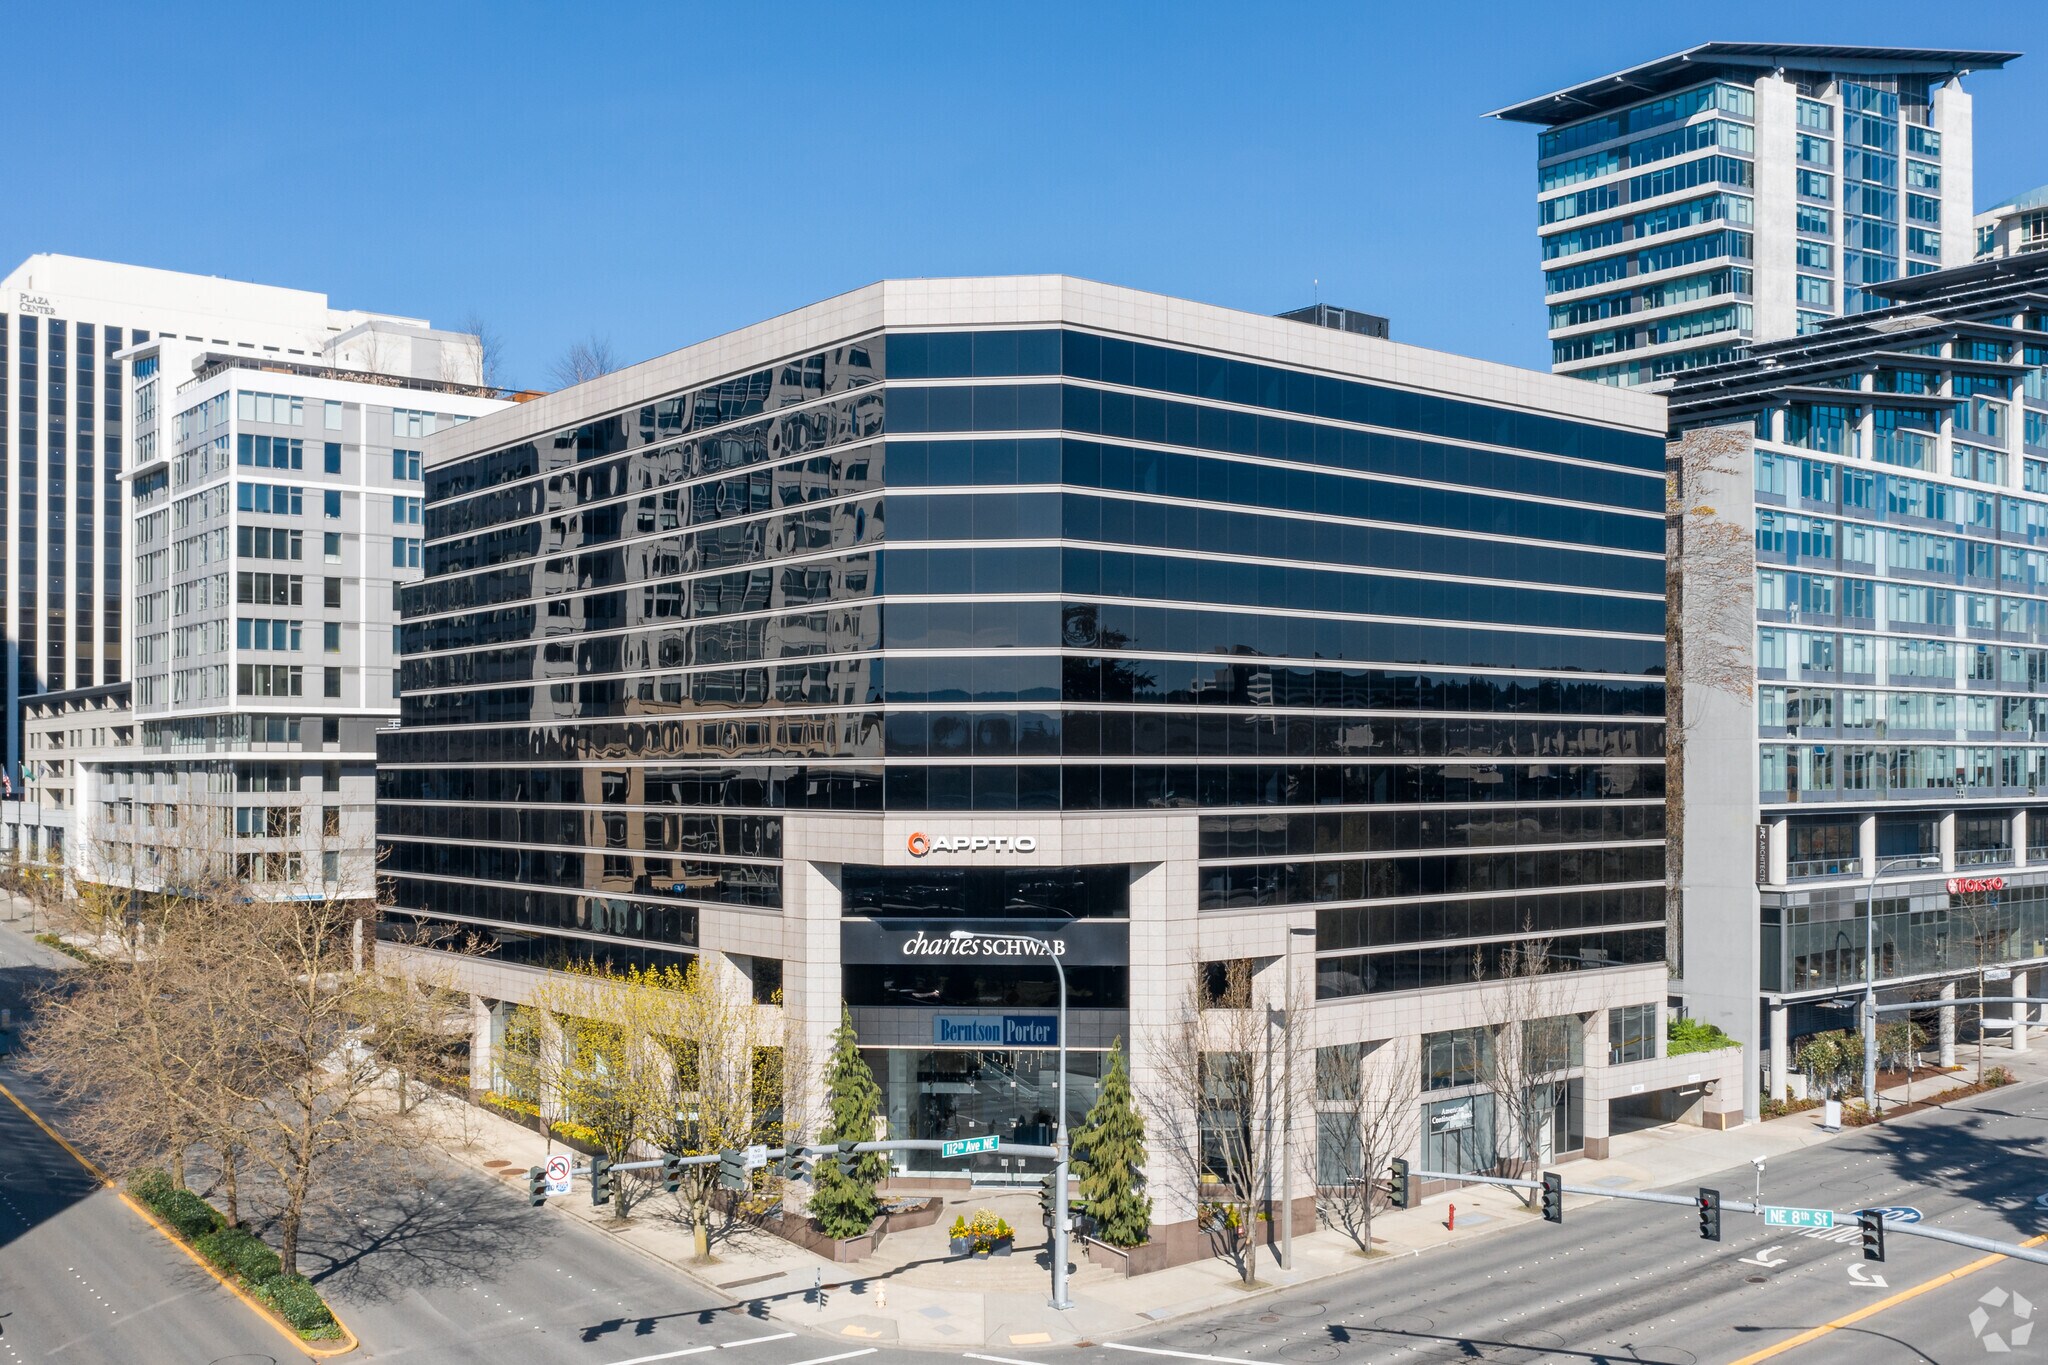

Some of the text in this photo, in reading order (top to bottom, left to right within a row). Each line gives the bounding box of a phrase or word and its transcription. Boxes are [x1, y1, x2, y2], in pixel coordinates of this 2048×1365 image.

[20, 293, 50, 305] PLAZA
[20, 302, 56, 315] CENTER
[932, 836, 1037, 853] APPTIO
[1956, 877, 2003, 893] TOKYO
[982, 939, 1066, 956] SCHWAB
[941, 1019, 1051, 1042] Berntson Porter
[946, 1138, 995, 1155] 112th Ave NE
[1770, 1209, 1828, 1226] NE 8th St
